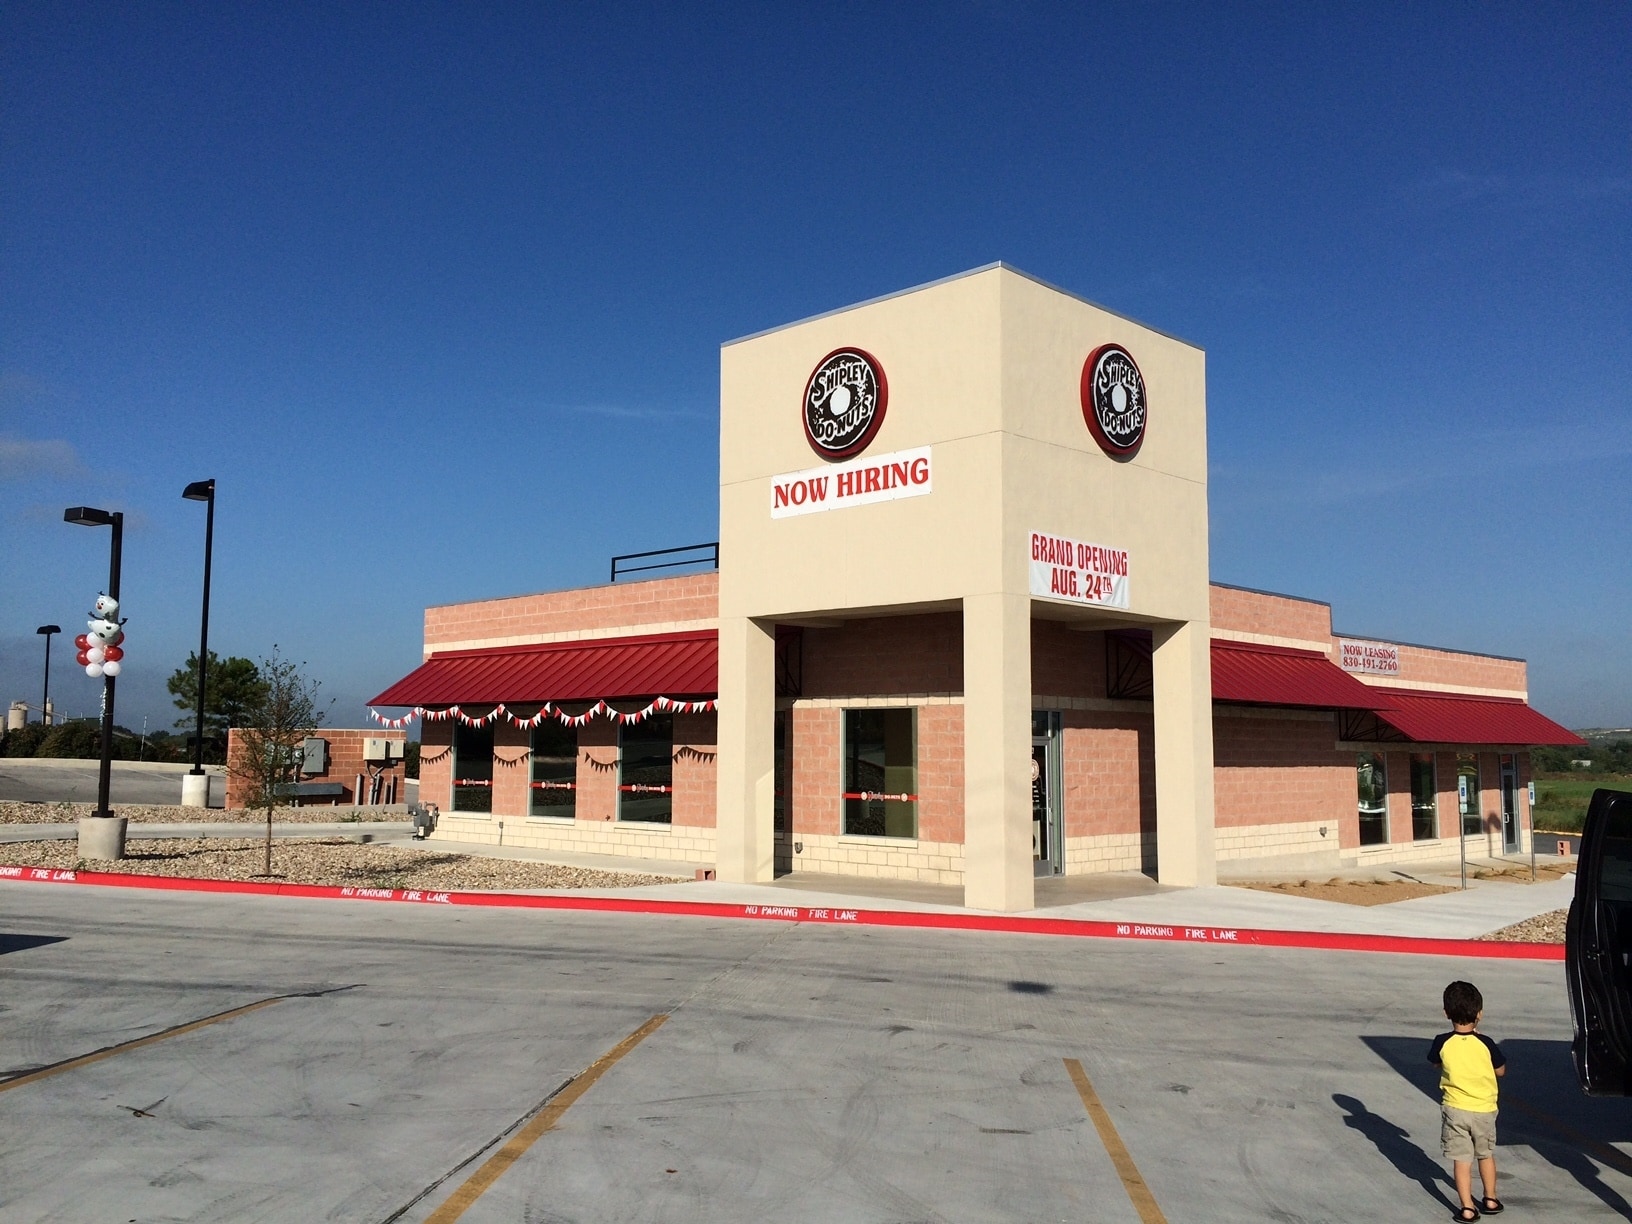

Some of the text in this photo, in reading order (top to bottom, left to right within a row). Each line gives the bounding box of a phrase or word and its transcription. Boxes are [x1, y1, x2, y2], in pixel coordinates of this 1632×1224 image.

[1100, 358, 1141, 390] SHIPLEY
[812, 363, 867, 403] SHIPLEY
[773, 458, 929, 509] NOW HIRING
[1032, 533, 1128, 577] GRAND OPENING
[1051, 567, 1081, 598] AUG.
[1343, 644, 1396, 660] NOW LEASING
[1343, 656, 1398, 671] 830-491-2760
[30, 868, 52, 879] FIRE
[53, 870, 78, 881] LANE
[341, 887, 452, 904] NO PARKING FIRE LANE
[745, 905, 859, 921] NO PARKING FIRE LANE
[1116, 924, 1238, 941] NO PARKING FIRE LANE
